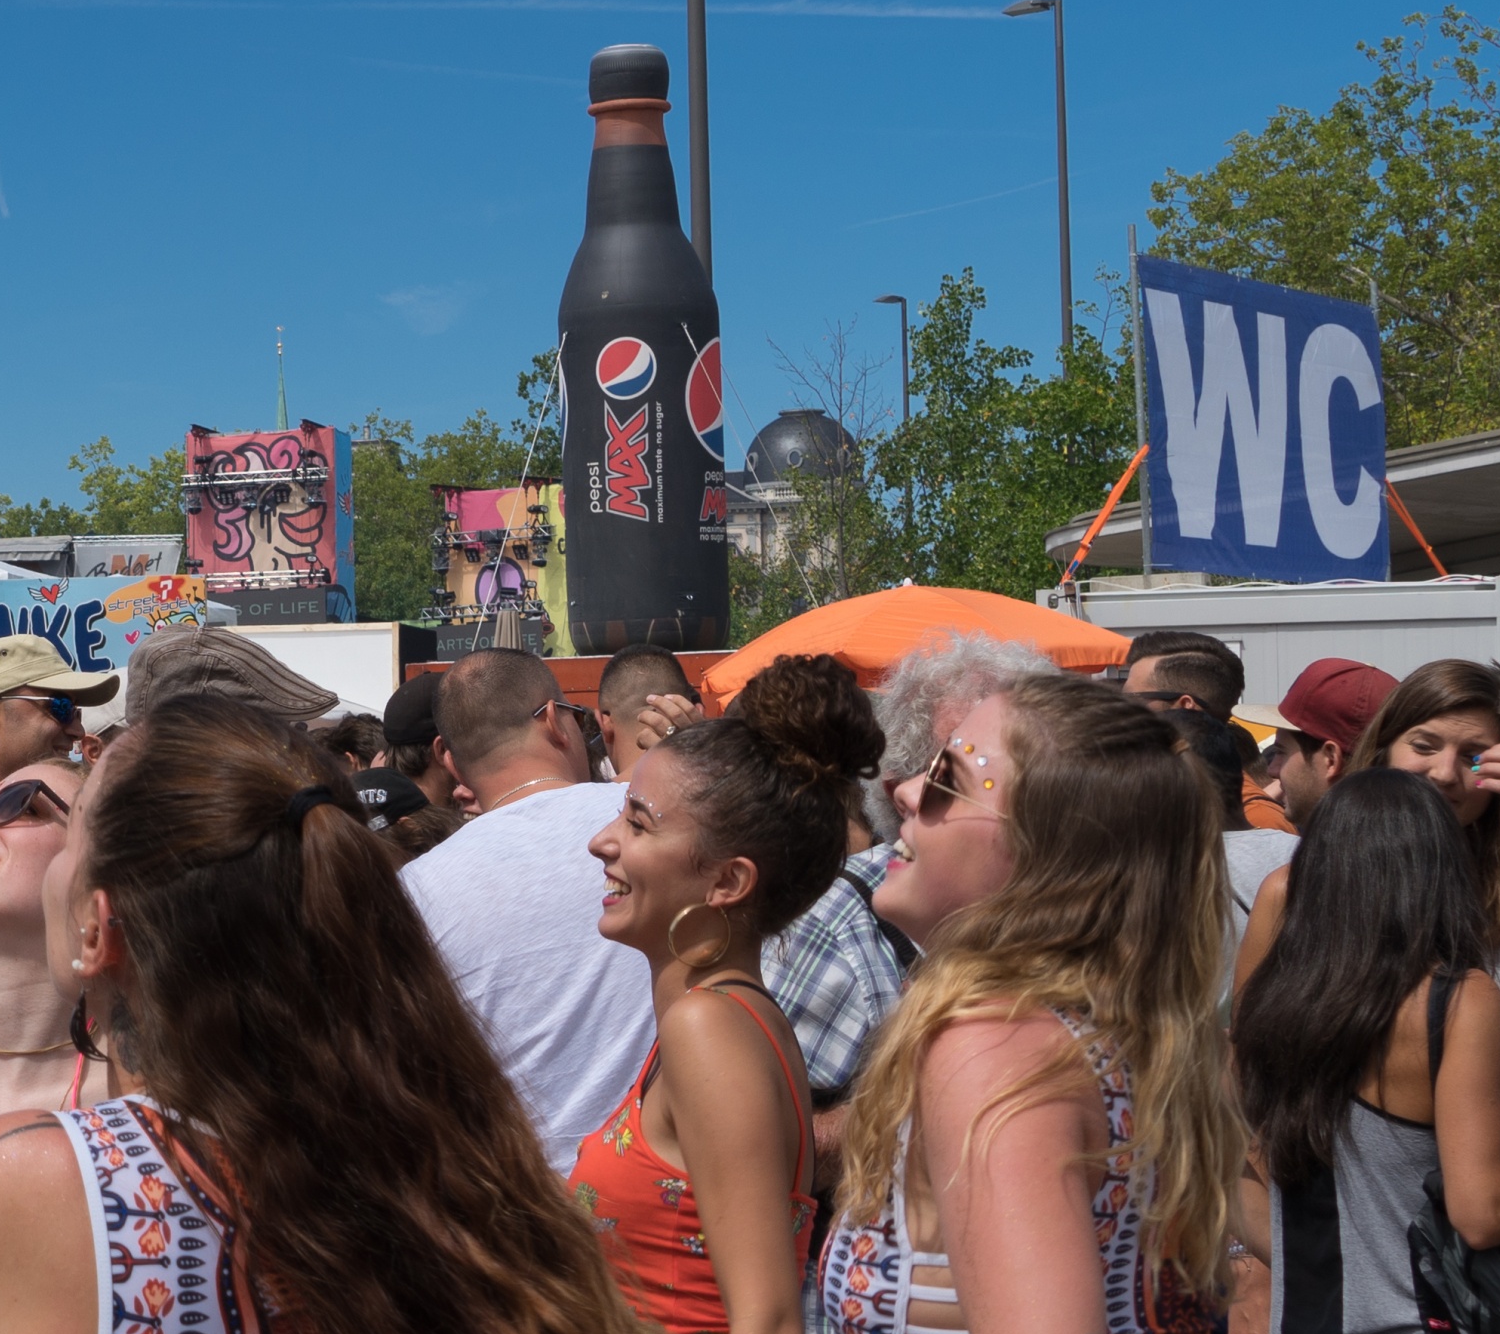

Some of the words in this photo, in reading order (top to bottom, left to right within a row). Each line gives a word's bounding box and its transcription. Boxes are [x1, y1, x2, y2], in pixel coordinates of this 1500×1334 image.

[655, 401, 664, 430] sugar
[1145, 287, 1381, 560] WC
[656, 432, 663, 444] no
[604, 400, 652, 522] MAX
[655, 452, 664, 474] taste
[587, 461, 603, 514] pepsi
[700, 524, 726, 533] maximu
[700, 533, 710, 541] no
[710, 533, 724, 543] sugar
[108, 593, 160, 612] street
[132, 598, 188, 619] parade
[249, 603, 274, 617] OF
[279, 600, 320, 615] LIFE
